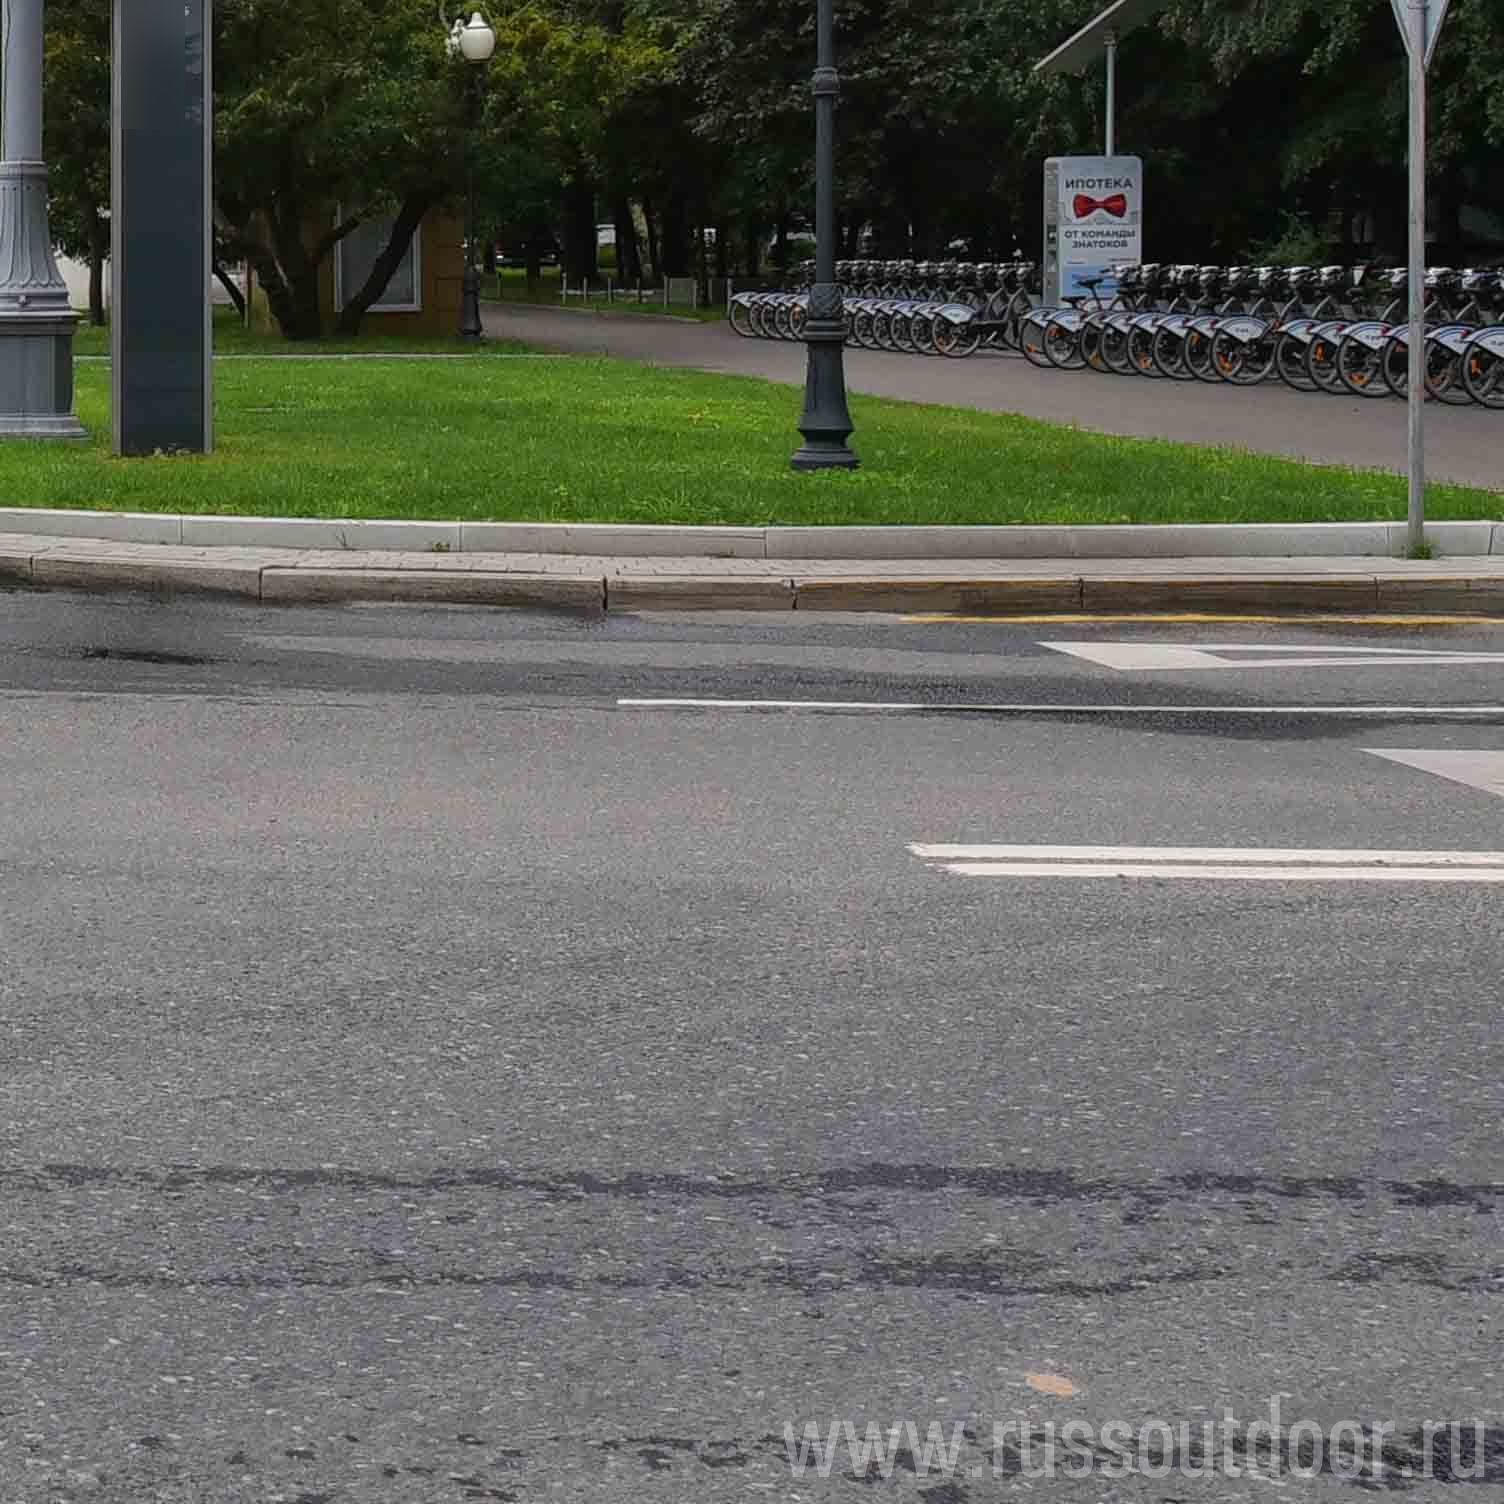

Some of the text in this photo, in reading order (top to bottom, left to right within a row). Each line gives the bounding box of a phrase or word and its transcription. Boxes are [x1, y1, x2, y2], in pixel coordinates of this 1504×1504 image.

[1065, 178, 1133, 189] ИПОТЕКА
[1064, 230, 1136, 238] ОТ КОМАНДЫ
[1072, 240, 1128, 248] ЗНАТОКОВ
